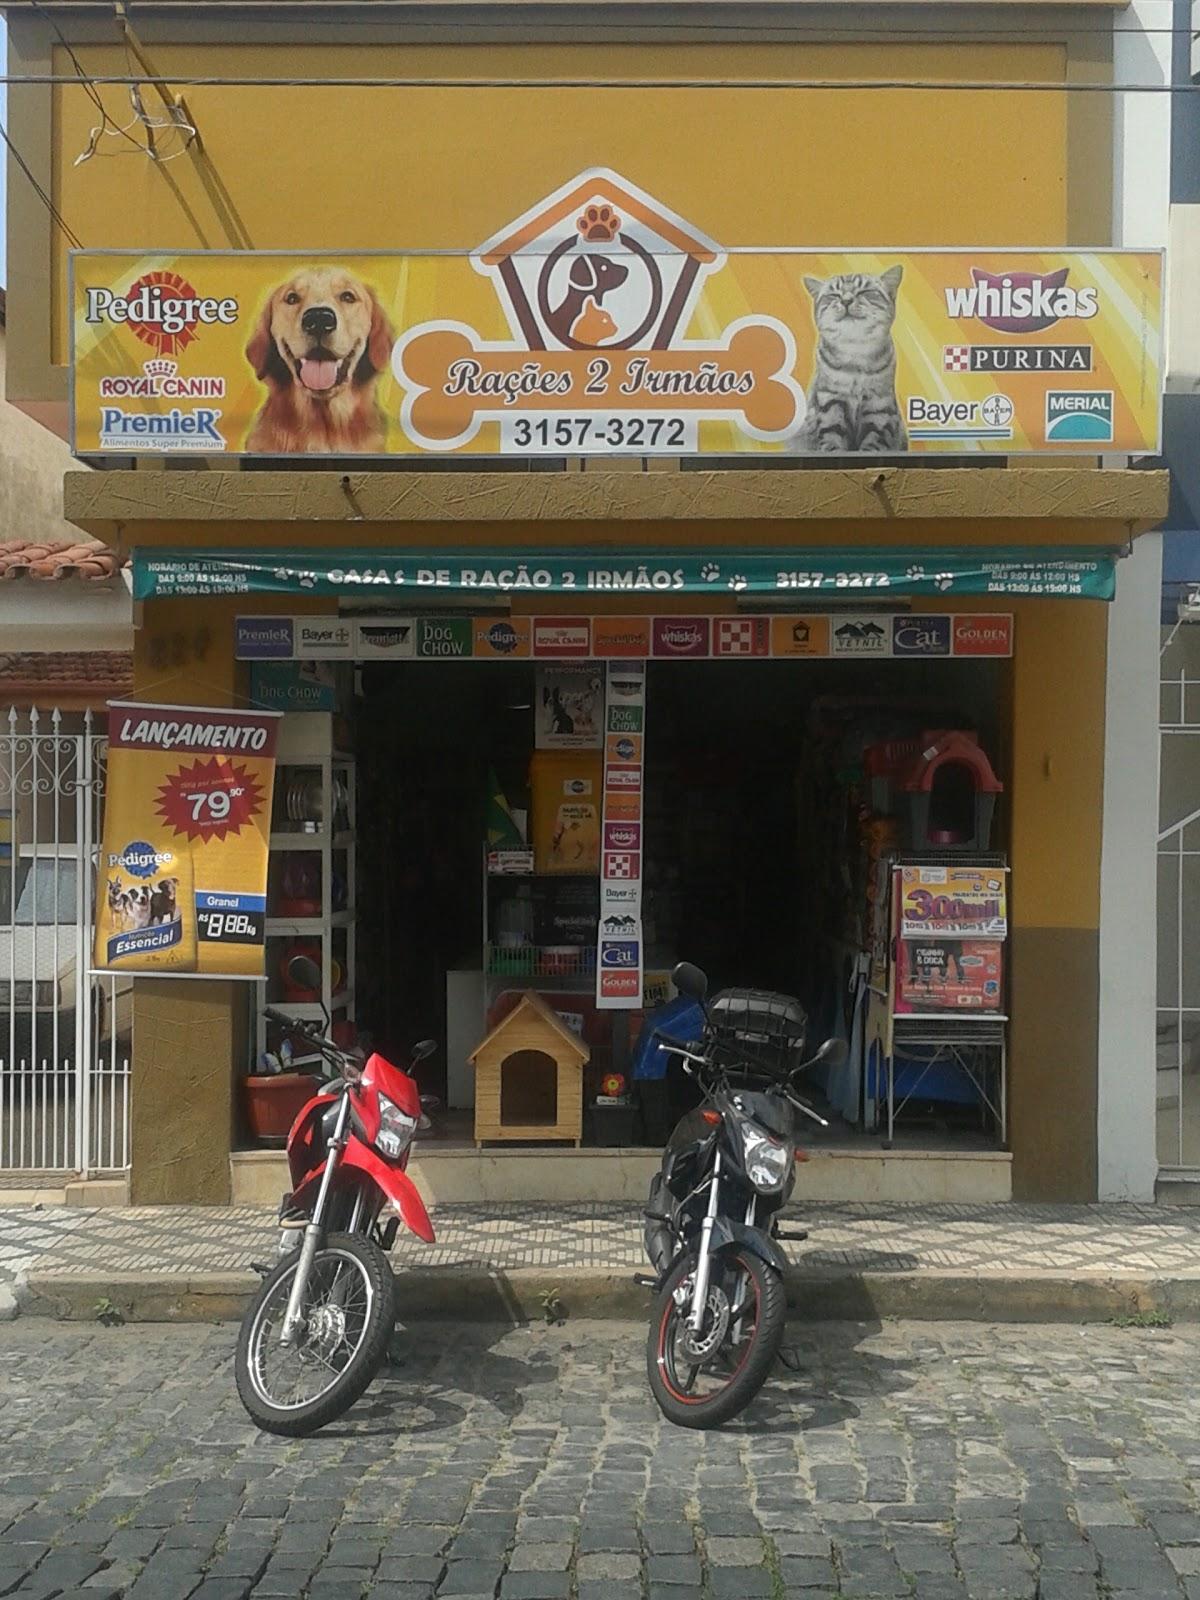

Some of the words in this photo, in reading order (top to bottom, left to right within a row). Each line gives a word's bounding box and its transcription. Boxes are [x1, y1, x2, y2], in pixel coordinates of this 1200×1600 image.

[945, 278, 1098, 319] whiskas
[86, 286, 238, 334] Pedigree
[974, 350, 1087, 369] PURINA
[101, 378, 159, 395] ROYAL
[160, 378, 224, 395] CANIN
[444, 358, 573, 404] Rações
[586, 359, 610, 394] 2
[621, 357, 755, 395] Irmãos
[908, 397, 979, 424] Bayer
[1049, 396, 1110, 411] MERIAL
[104, 409, 218, 440] PremieR
[513, 417, 686, 448] 3157-3272
[103, 438, 150, 448] Alimentos
[152, 438, 179, 449] Super
[181, 438, 224, 449] Premium
[326, 568, 405, 585] CASAS
[417, 569, 451, 586] DE
[460, 565, 553, 590] RAÇÃO
[562, 571, 576, 588] 2
[587, 566, 685, 589] IRMÃOS
[775, 571, 891, 588] 3157-3272
[301, 628, 334, 641] Bayer
[423, 625, 453, 641] DOG
[660, 631, 703, 644] whiskas
[894, 627, 942, 649] Cat
[421, 640, 464, 656] CHOW
[611, 709, 632, 721] DOG
[119, 718, 268, 751] LANÇAMENTO
[610, 720, 639, 732] CHOW
[186, 790, 231, 821] 79
[108, 851, 173, 867] Pedigree
[206, 895, 239, 908] Granel
[115, 928, 174, 954] Essencial
[602, 948, 633, 965] Cat
